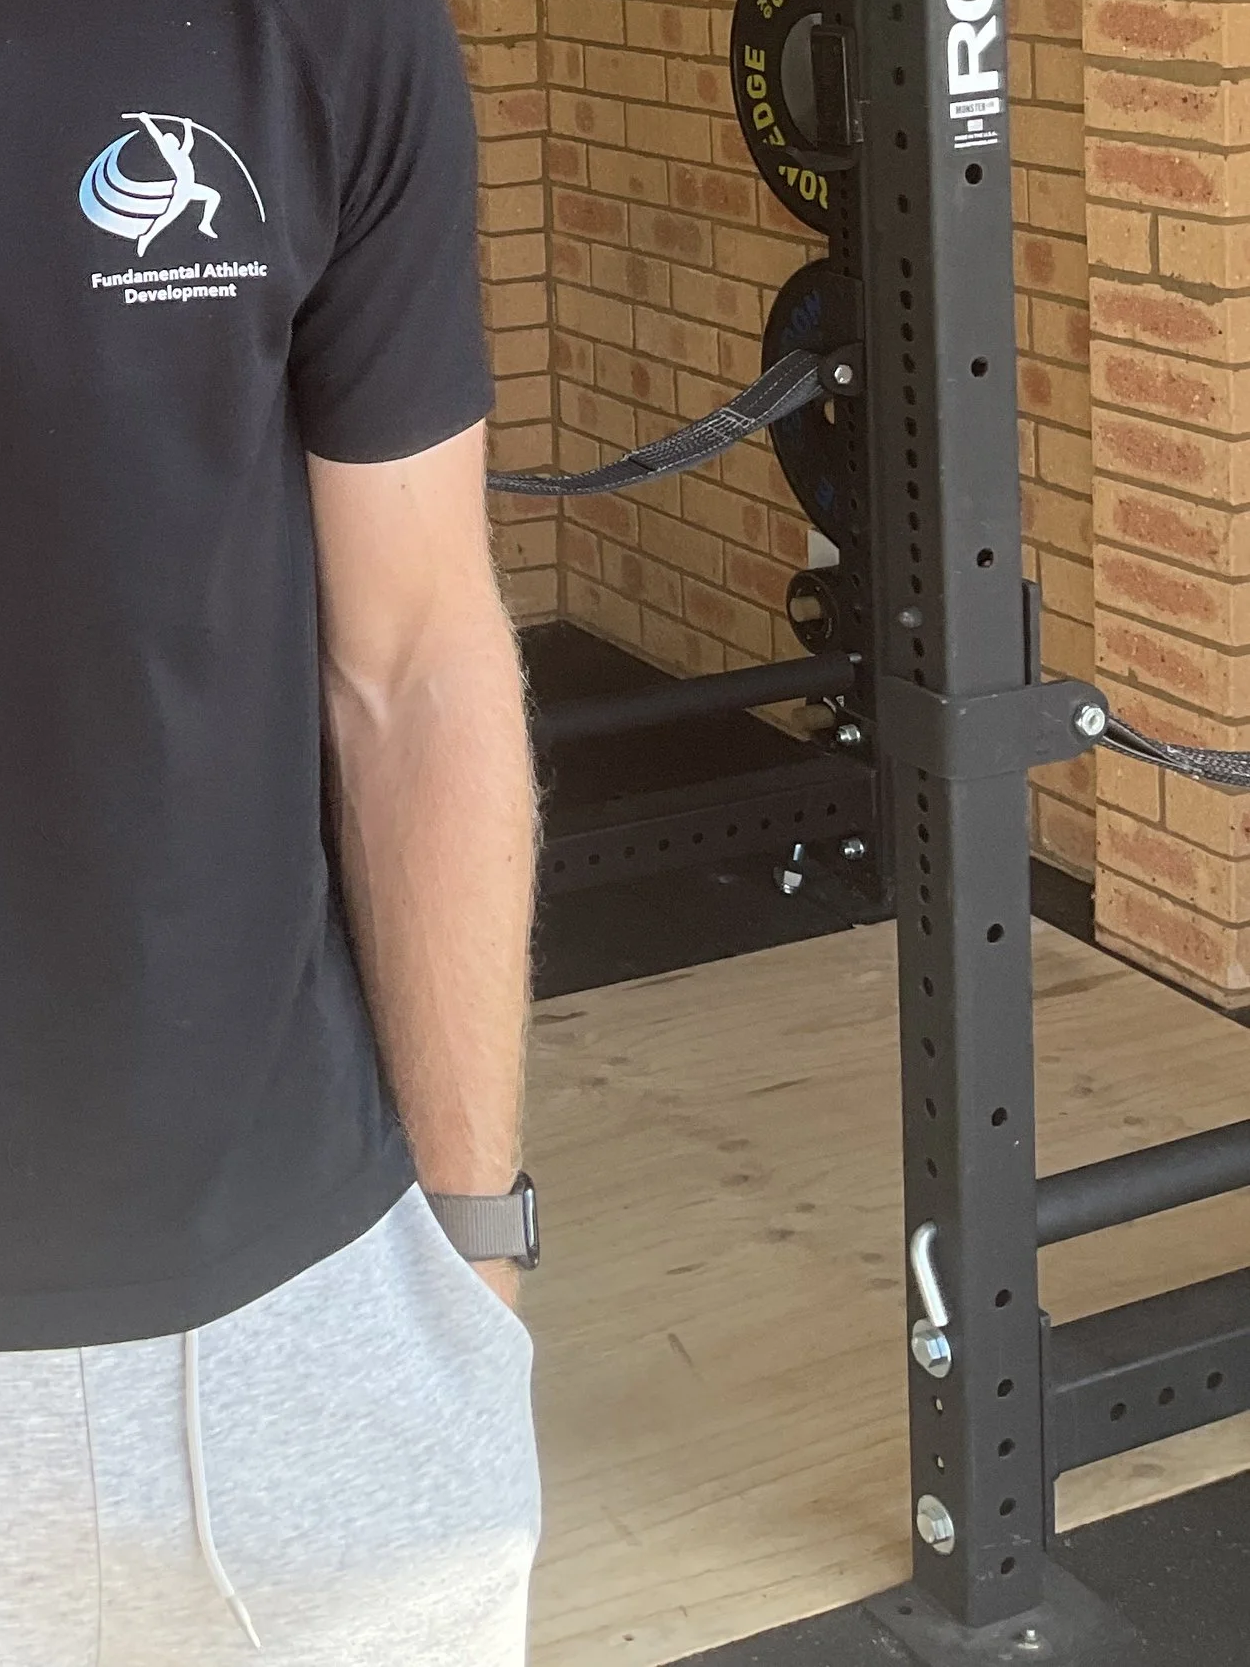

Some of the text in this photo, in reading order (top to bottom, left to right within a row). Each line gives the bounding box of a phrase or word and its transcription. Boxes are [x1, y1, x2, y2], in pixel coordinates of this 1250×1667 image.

[91, 260, 268, 289] Fundamental Athletic
[124, 283, 237, 304] Development
